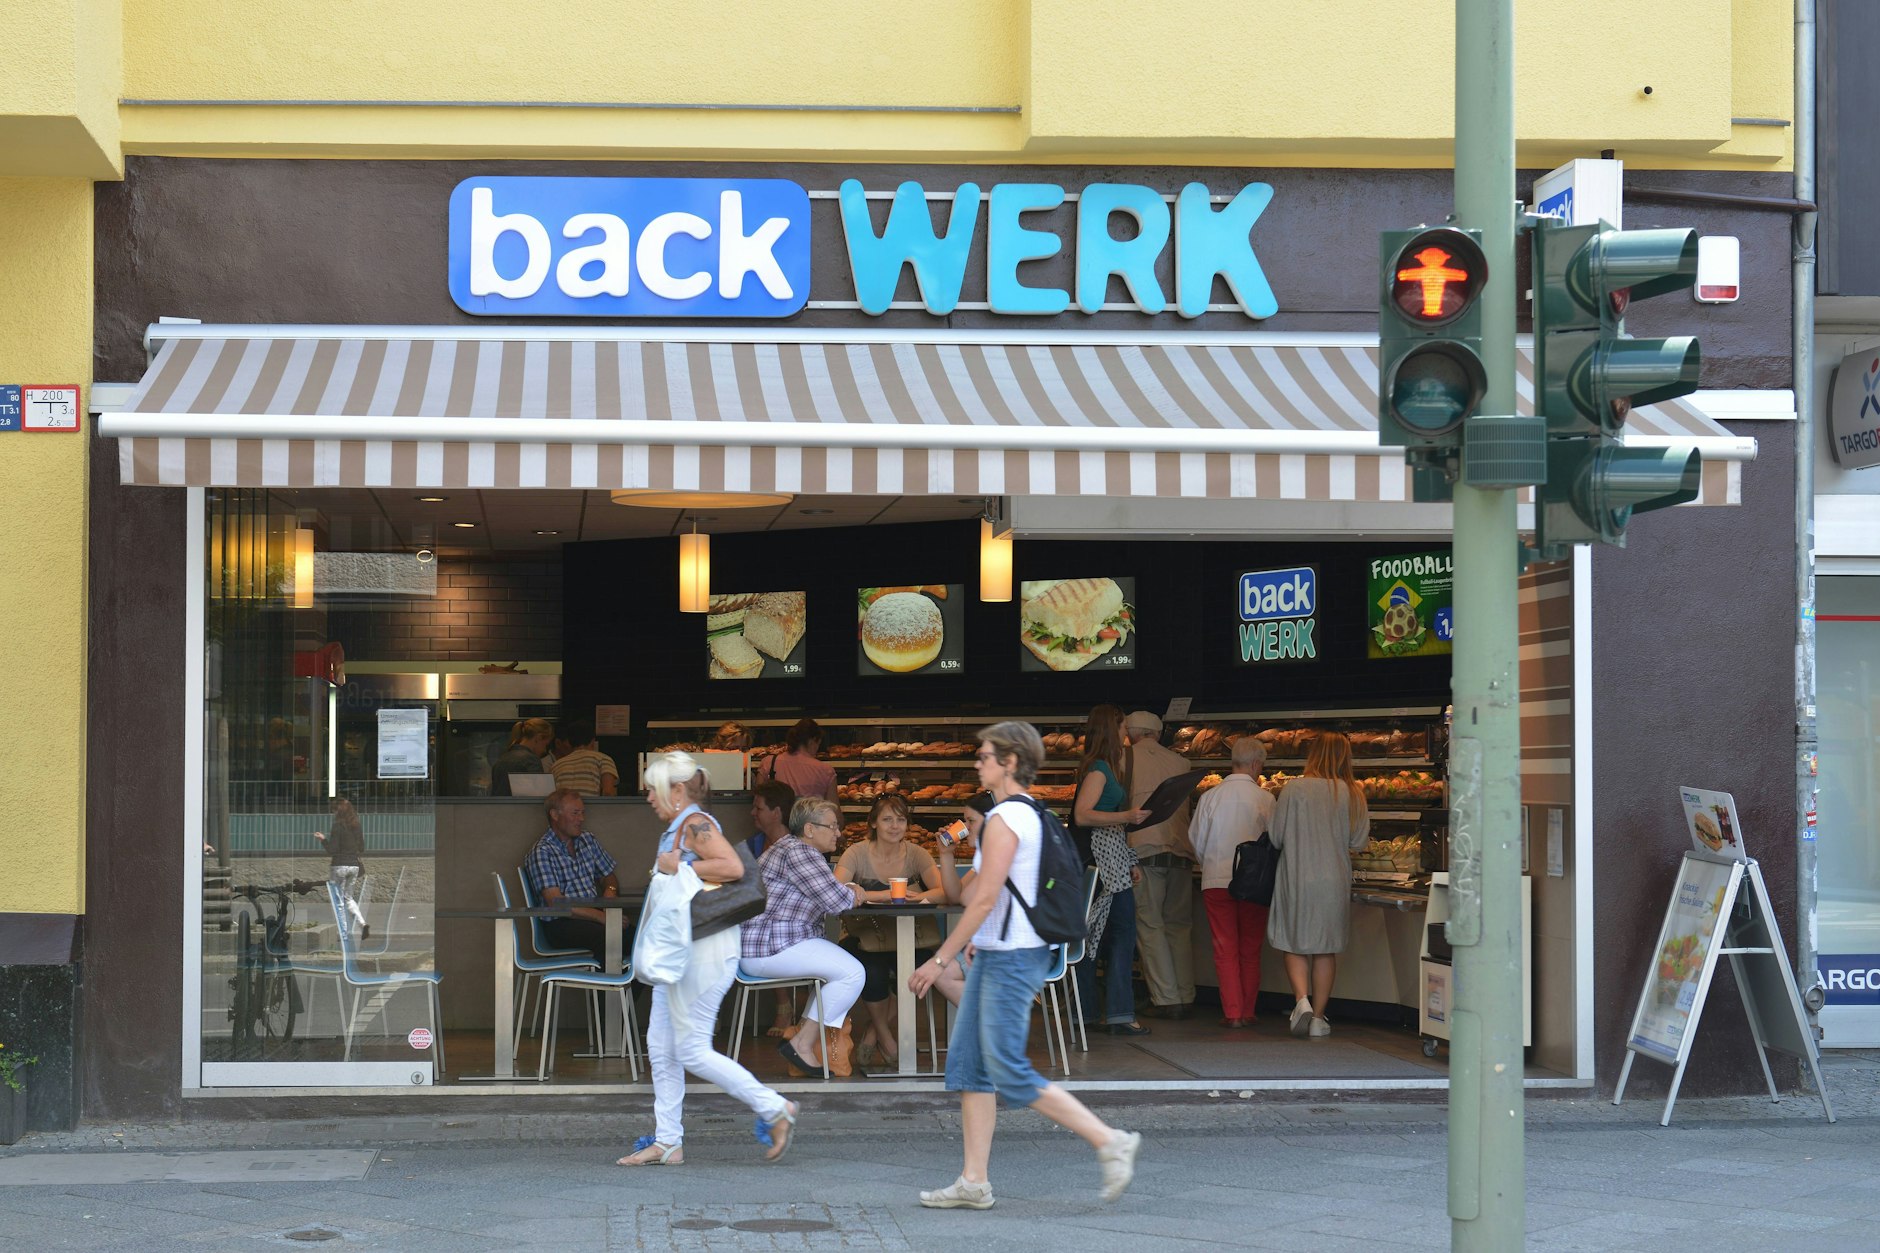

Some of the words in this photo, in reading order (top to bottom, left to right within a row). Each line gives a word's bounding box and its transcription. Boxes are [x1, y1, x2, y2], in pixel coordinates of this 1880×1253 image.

[470, 186, 794, 300] back
[839, 178, 1279, 319] WERK
[42, 390, 62, 400] 200
[61, 404, 75, 415] 3.0
[47, 416, 61, 427] 2.5
[1371, 555, 1454, 580] FOODBALL
[1244, 573, 1312, 615] back
[1239, 618, 1316, 662] WERK
[940, 660, 961, 669] 0,59€
